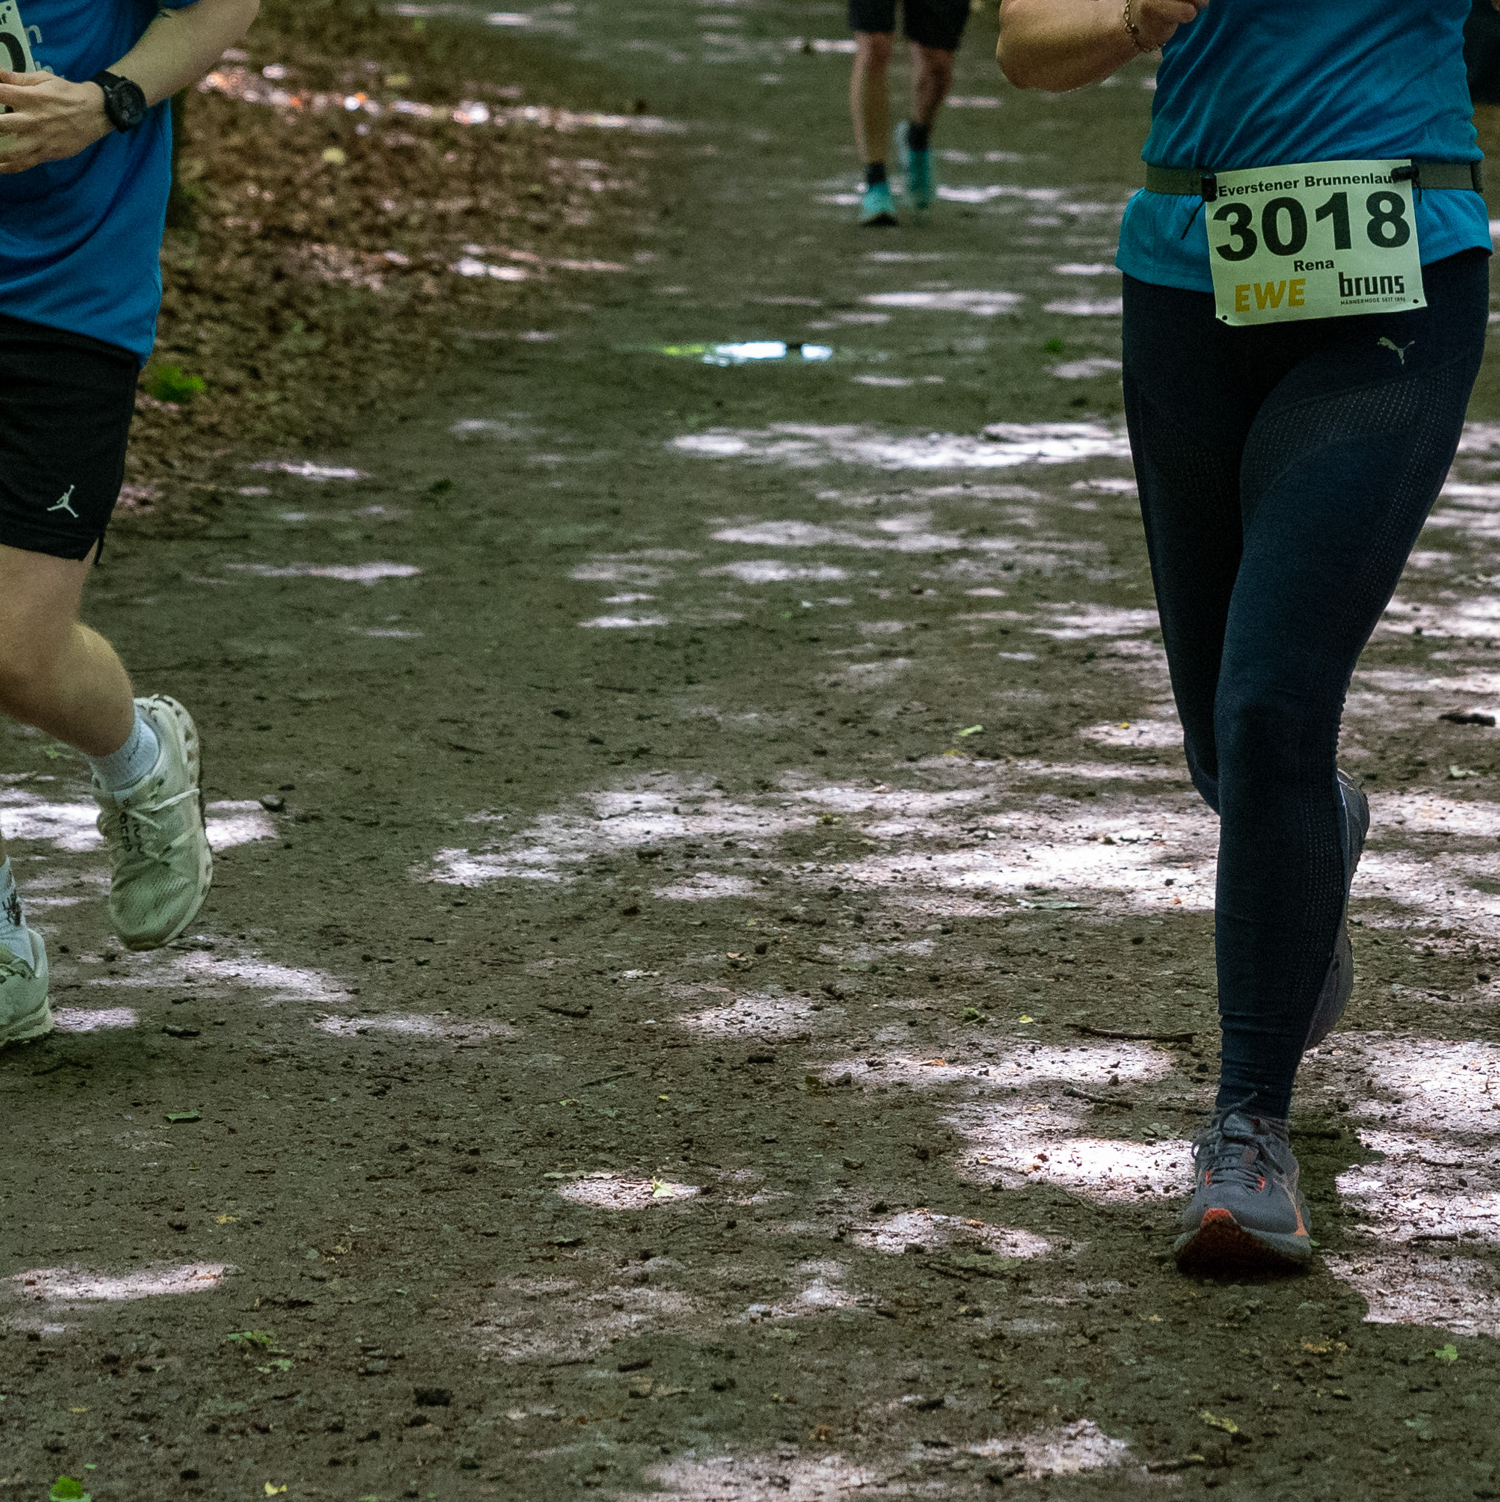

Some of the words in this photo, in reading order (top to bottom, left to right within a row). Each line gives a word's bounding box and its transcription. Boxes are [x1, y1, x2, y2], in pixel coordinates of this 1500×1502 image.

[1218, 179, 1300, 197] Everstener
[1304, 172, 1397, 188] Brunnenlau
[1212, 190, 1411, 262] 3018
[1293, 259, 1335, 272] Rena
[1235, 278, 1306, 312] EWE
[1338, 272, 1405, 298] bruns
